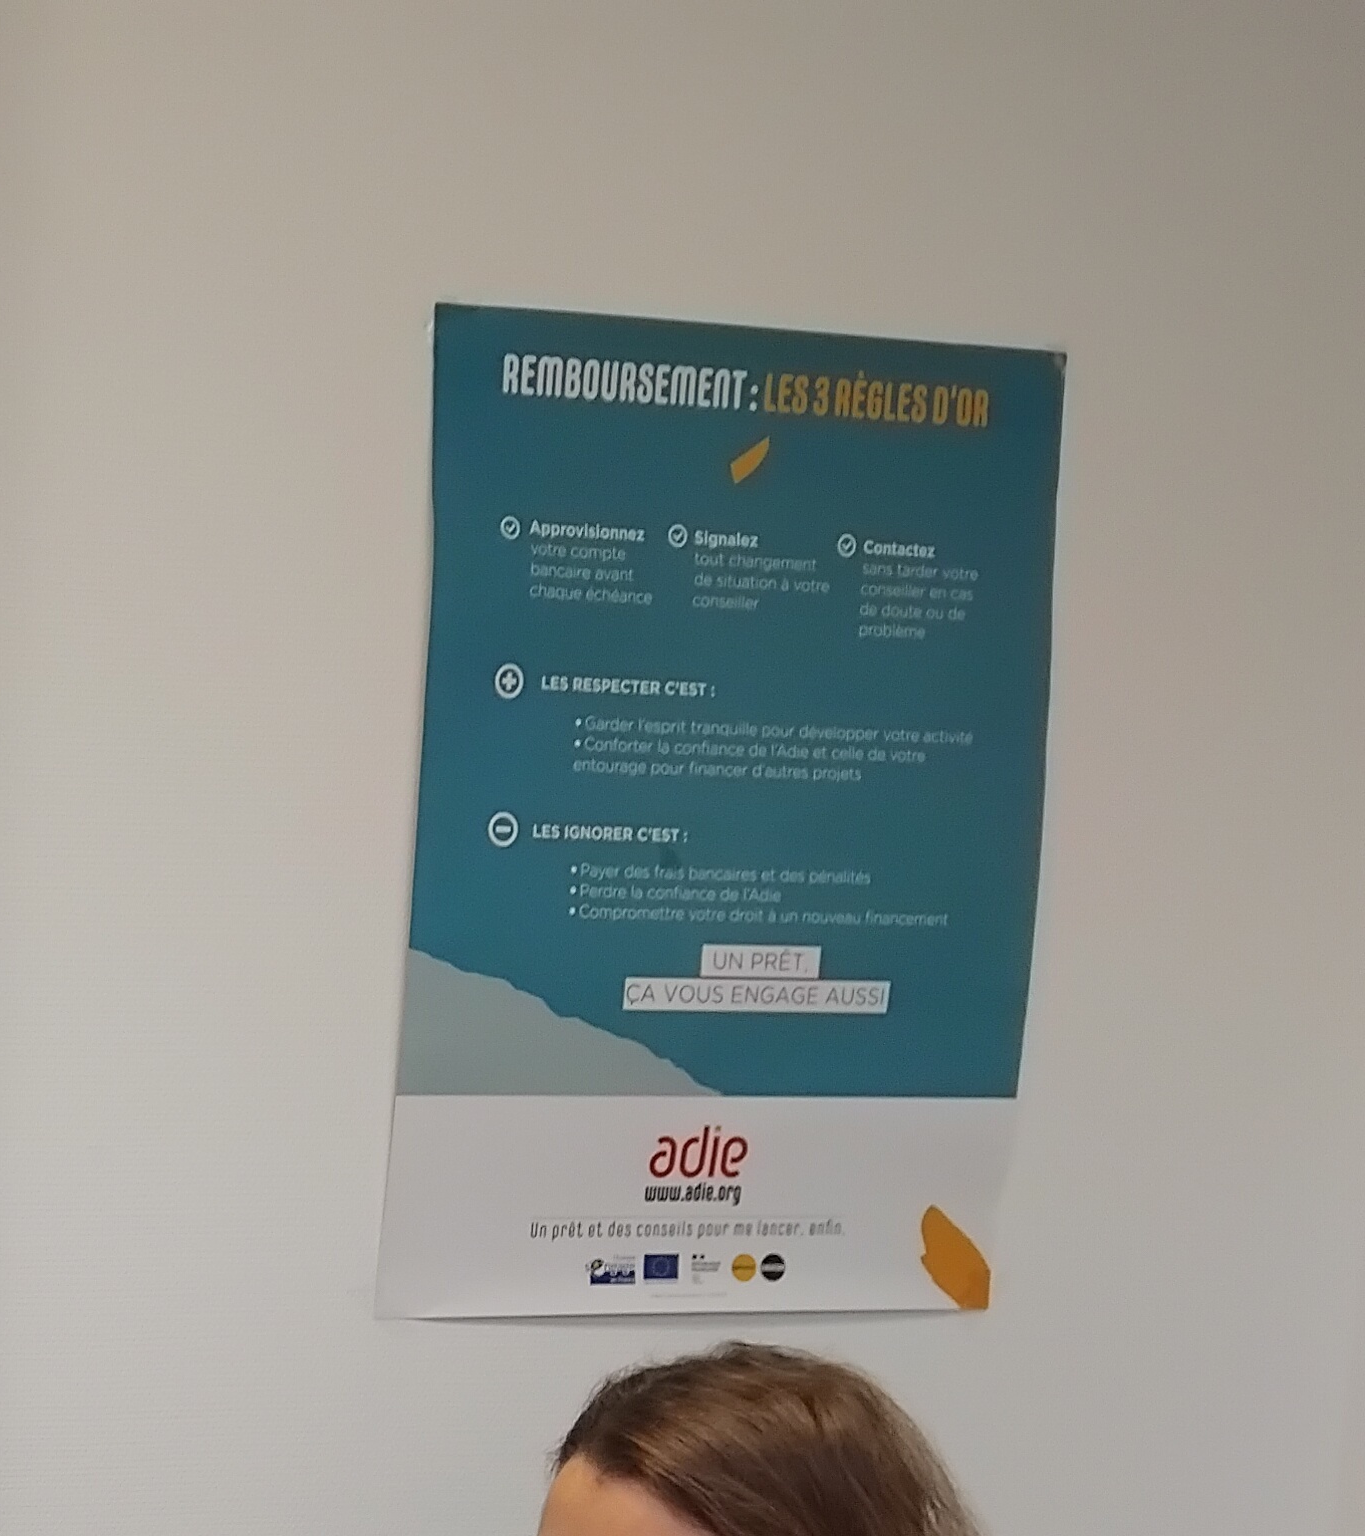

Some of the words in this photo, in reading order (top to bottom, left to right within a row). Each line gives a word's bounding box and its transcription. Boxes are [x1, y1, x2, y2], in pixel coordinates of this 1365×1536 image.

[763, 373, 809, 415] LES
[813, 376, 830, 417] 3
[834, 370, 927, 424] RÈGLES
[932, 384, 989, 428] D'OR
[529, 519, 646, 542] Approvisionnez
[694, 530, 759, 549] Signalez
[531, 543, 567, 557] votre
[570, 546, 626, 562] compte
[863, 539, 936, 559] Contactez
[530, 562, 591, 580] bancaire
[594, 568, 634, 582] avant
[694, 552, 725, 567] tout
[729, 554, 817, 572] changement
[862, 562, 893, 577] sans
[897, 563, 939, 579] tarder
[942, 568, 980, 582] votre
[694, 572, 713, 587] de
[717, 574, 777, 590] situation
[780, 578, 789, 592] à
[793, 580, 831, 593] votre
[860, 583, 926, 598] conseiller
[929, 587, 947, 599] en
[950, 588, 974, 601] cas
[529, 583, 582, 600] chaque
[585, 585, 653, 605] échéance
[692, 595, 760, 610] conseiller
[859, 603, 878, 617] de
[881, 604, 922, 619] doute
[926, 608, 944, 620] ou
[947, 605, 966, 621] de
[859, 624, 926, 639] problème
[541, 675, 568, 692] LES
[572, 676, 661, 696] RESPECTER
[664, 680, 707, 698] C'EST
[584, 715, 635, 733] Garder
[638, 717, 686, 735] l'esprit
[691, 721, 758, 738] tranquille
[761, 725, 795, 739] pour
[799, 724, 880, 742] développer
[883, 730, 920, 743] votre
[922, 730, 973, 745] activité
[584, 736, 653, 752] Conforter
[658, 739, 669, 756] la
[674, 740, 745, 757] confiance
[749, 744, 767, 757] de
[771, 745, 809, 759] l'Adie
[813, 747, 828, 759] et
[831, 746, 864, 761] celle
[868, 749, 886, 762] de
[891, 751, 926, 763] votre
[573, 758, 647, 776] entourage
[650, 763, 685, 777] pour
[689, 761, 747, 778] financer
[752, 765, 809, 780] d'autres
[813, 767, 862, 782] projets
[533, 824, 560, 839] LES
[564, 825, 633, 842] IGNORER
[636, 827, 680, 843] C'EST
[580, 862, 619, 881] Payer
[624, 864, 650, 880] des
[654, 864, 685, 881] frais
[688, 866, 757, 882] bancaires
[760, 870, 776, 882] et
[779, 869, 805, 883] des
[808, 869, 871, 885] pénalités
[579, 883, 626, 899] Perdre
[631, 885, 643, 899] la
[646, 885, 716, 901] confiance
[720, 887, 739, 901] de
[743, 887, 782, 902] l'Adie
[579, 904, 684, 922] Compromettre
[688, 908, 726, 922] votre
[728, 908, 763, 922] droit
[767, 909, 776, 923] à
[780, 912, 798, 923] un
[802, 912, 861, 925] nouveau
[865, 910, 948, 926] financement
[713, 952, 743, 970] UN
[626, 984, 655, 1005] ÇA
[665, 984, 724, 1004] VOUS
[731, 985, 818, 1005] ENGAGE
[825, 987, 884, 1006] AUSSI
[649, 1125, 748, 1178] adie
[644, 1183, 742, 1206] www.adie.org
[530, 1222, 547, 1238] Un
[551, 1221, 584, 1241] prêt
[588, 1222, 603, 1238] et
[608, 1221, 631, 1238] des
[636, 1221, 693, 1238] conseils
[697, 1222, 729, 1240] pour
[733, 1222, 752, 1236] me
